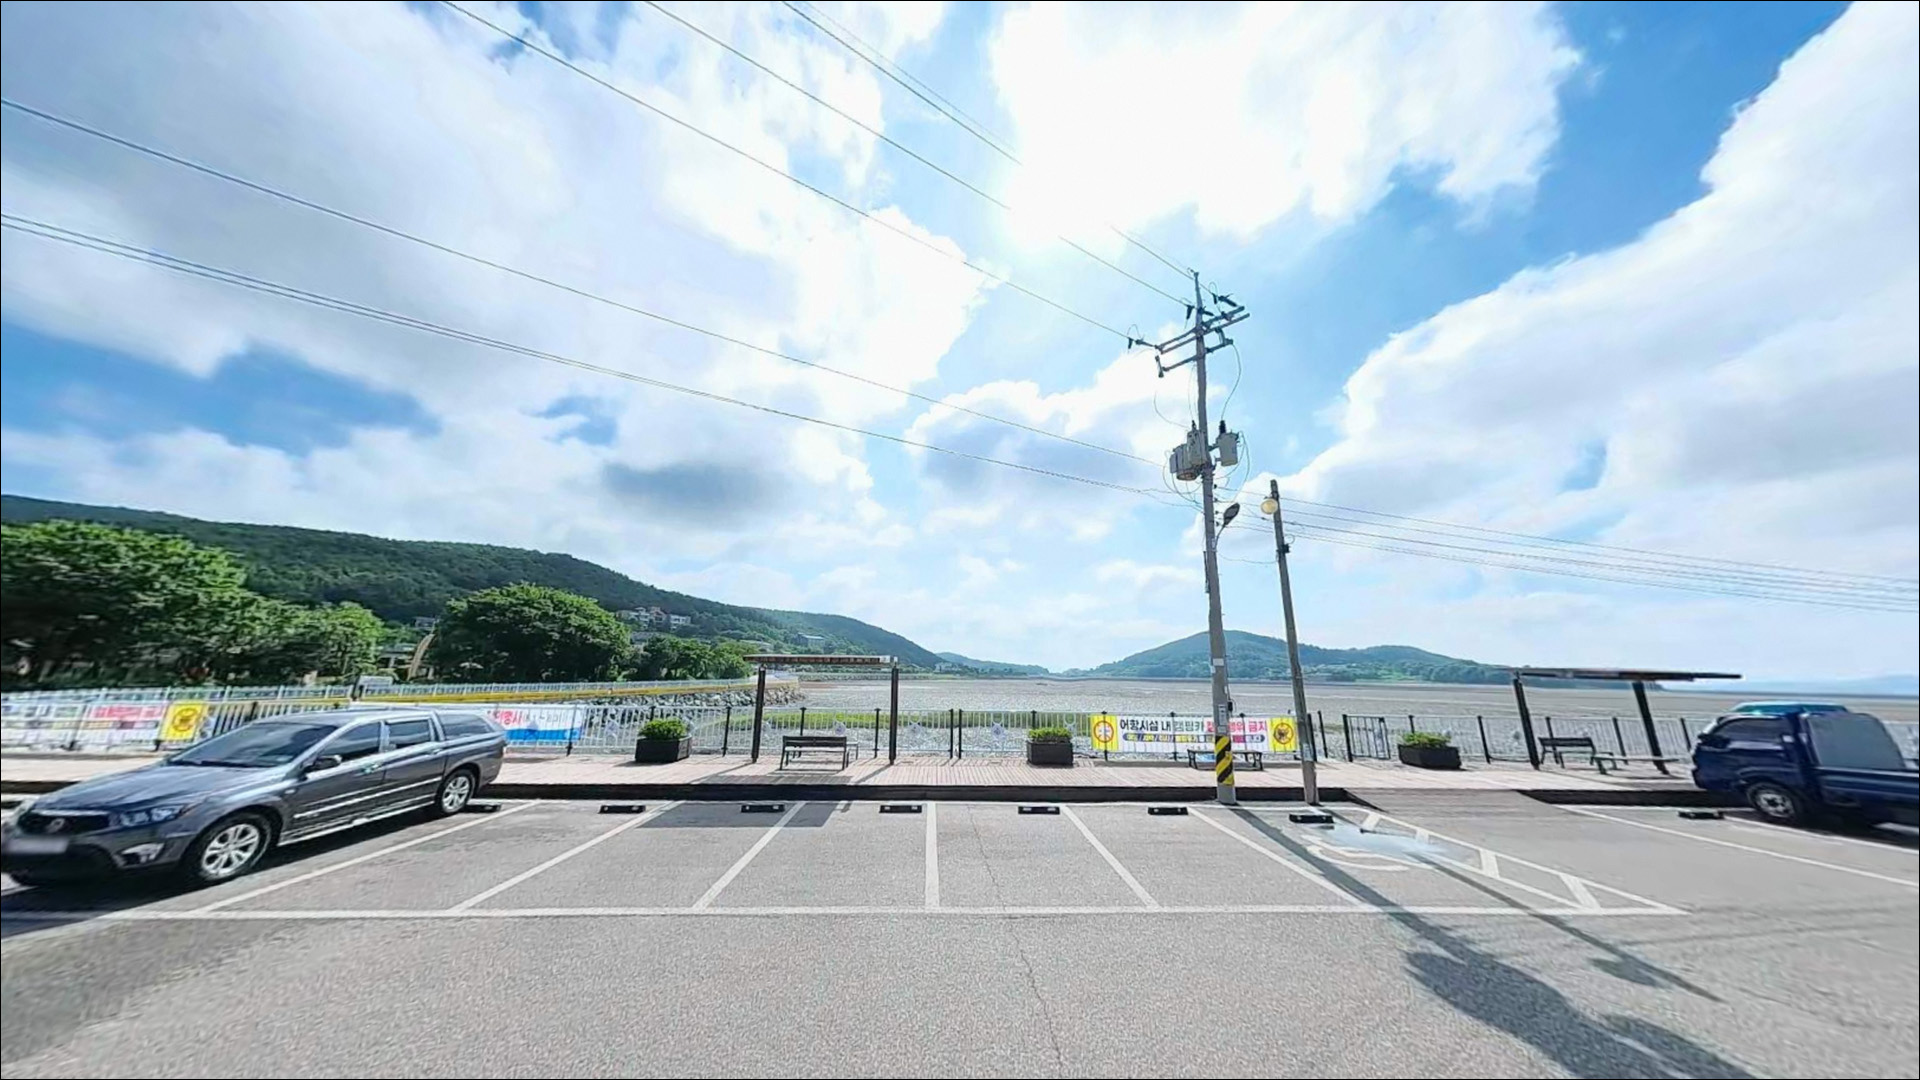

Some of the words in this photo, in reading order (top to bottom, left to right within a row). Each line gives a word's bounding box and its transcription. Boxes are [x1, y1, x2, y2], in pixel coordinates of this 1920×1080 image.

[1119, 719, 1158, 732] 어항시설
[1161, 720, 1171, 732] 내
[1248, 720, 1267, 733] 금지
